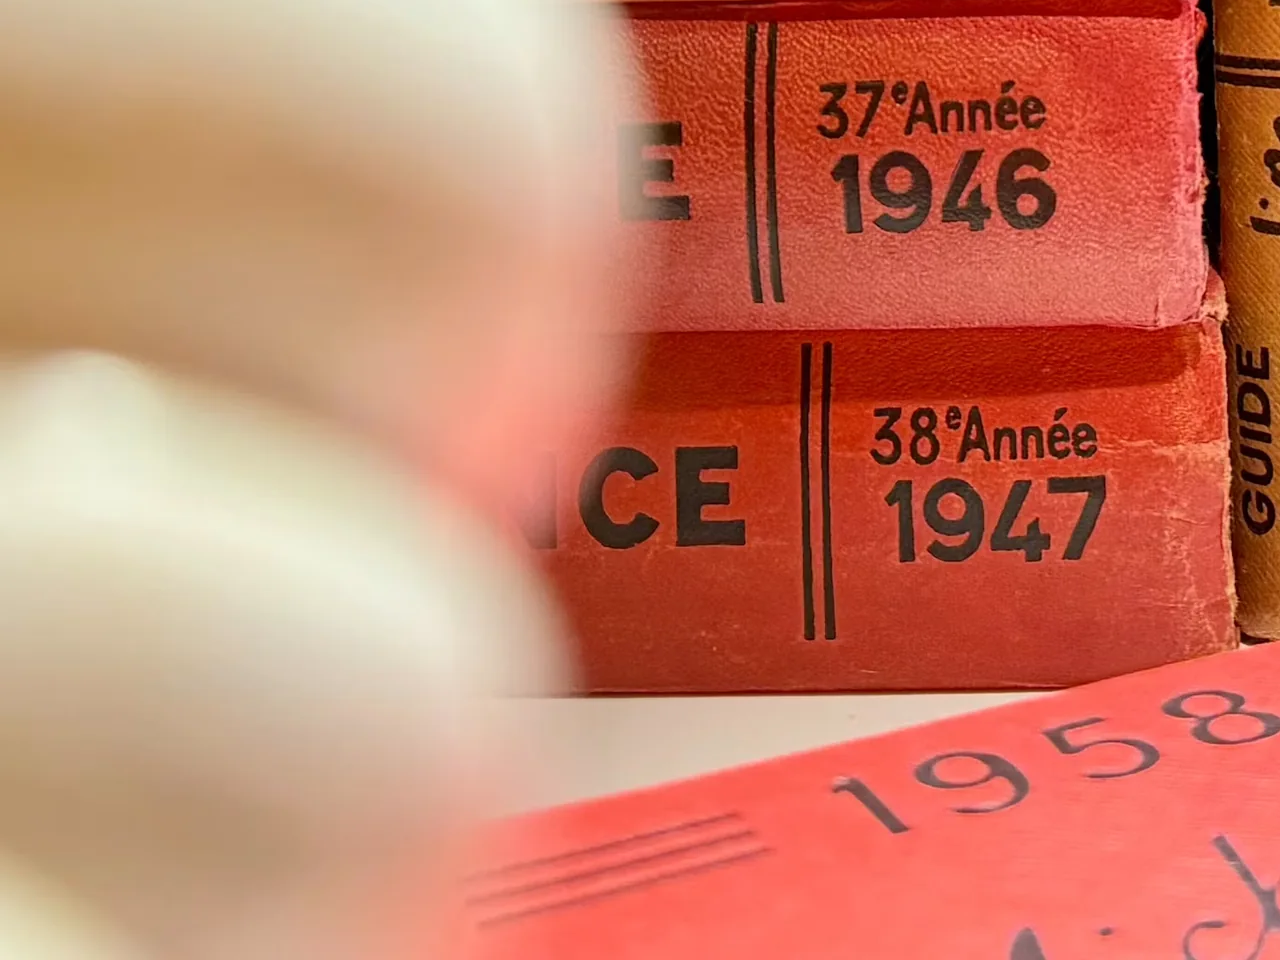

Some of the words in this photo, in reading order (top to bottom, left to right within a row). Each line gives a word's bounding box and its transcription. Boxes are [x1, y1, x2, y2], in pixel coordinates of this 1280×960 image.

[904, 79, 1047, 136] Année
[830, 148, 1058, 235] 1946
[958, 407, 1097, 464] Année
[1235, 343, 1276, 537] GUIDE
[884, 474, 1107, 564] 1947
